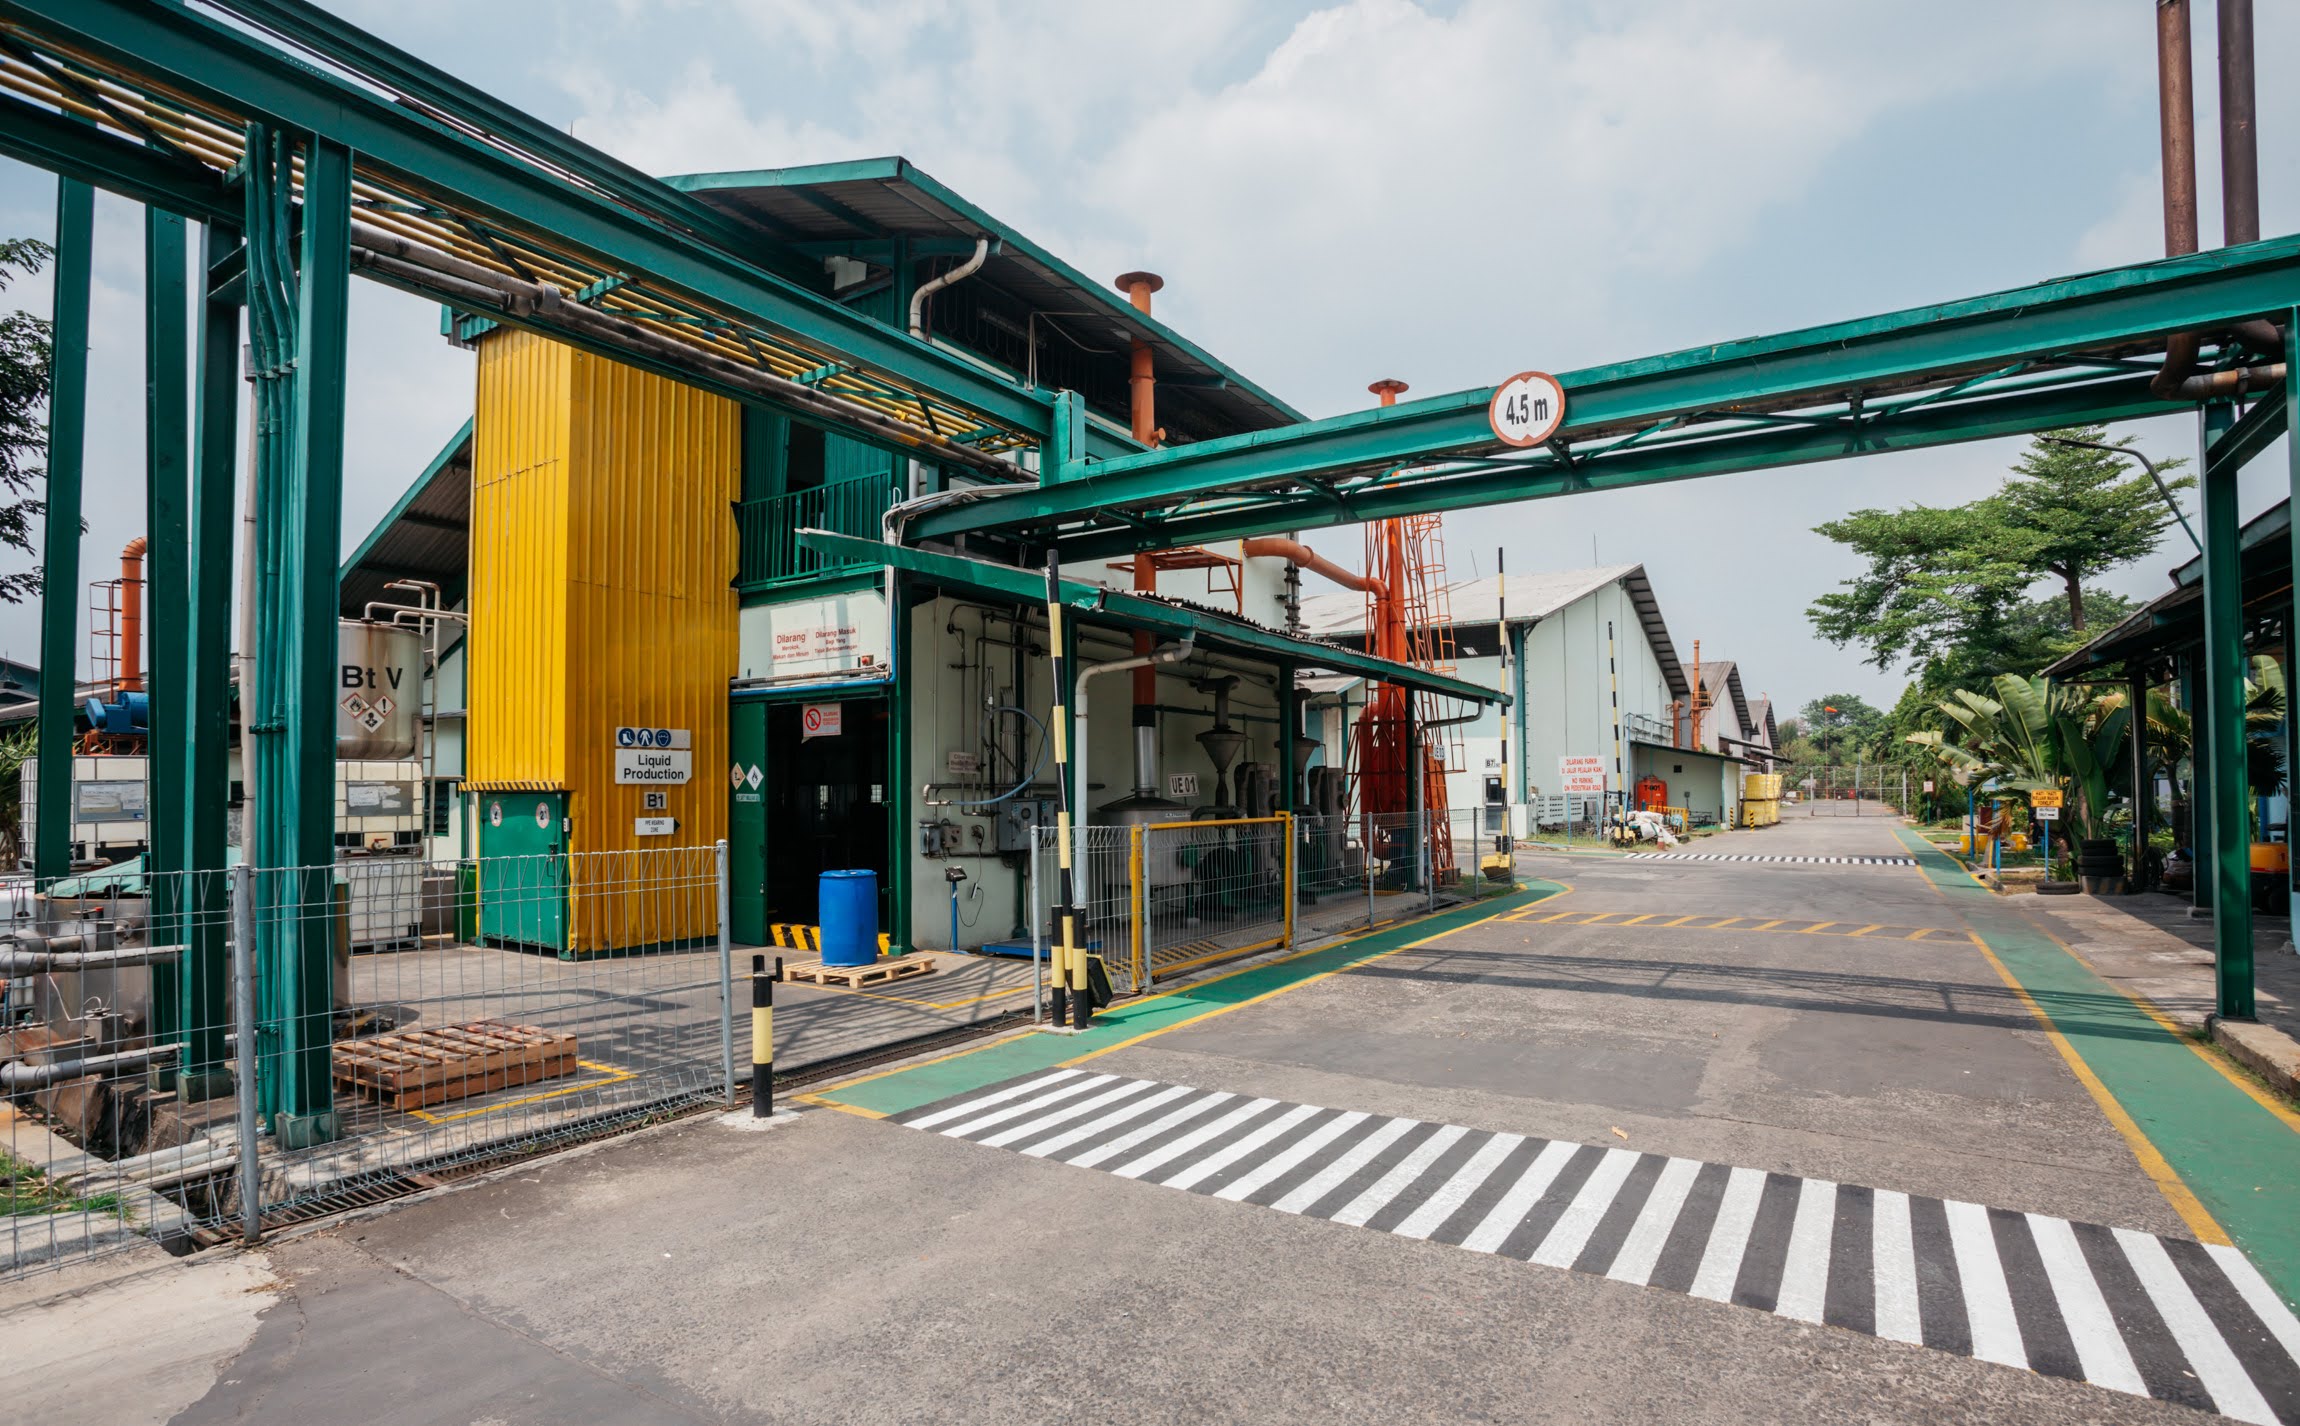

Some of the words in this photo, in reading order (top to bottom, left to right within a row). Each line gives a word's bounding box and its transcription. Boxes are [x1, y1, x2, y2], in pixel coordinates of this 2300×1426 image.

[1506, 394, 1529, 425] 4.5
[1534, 398, 1548, 421] m
[776, 633, 806, 644] Dilarang
[815, 631, 837, 639] Dilarang
[838, 627, 856, 635] Masuk
[342, 665, 376, 689] Bt
[385, 667, 403, 690] V
[638, 754, 671, 768] Liquid
[623, 768, 684, 779] Production
[1171, 777, 1183, 793] UE
[1184, 776, 1196, 793] 01
[647, 793, 664, 808] B1
